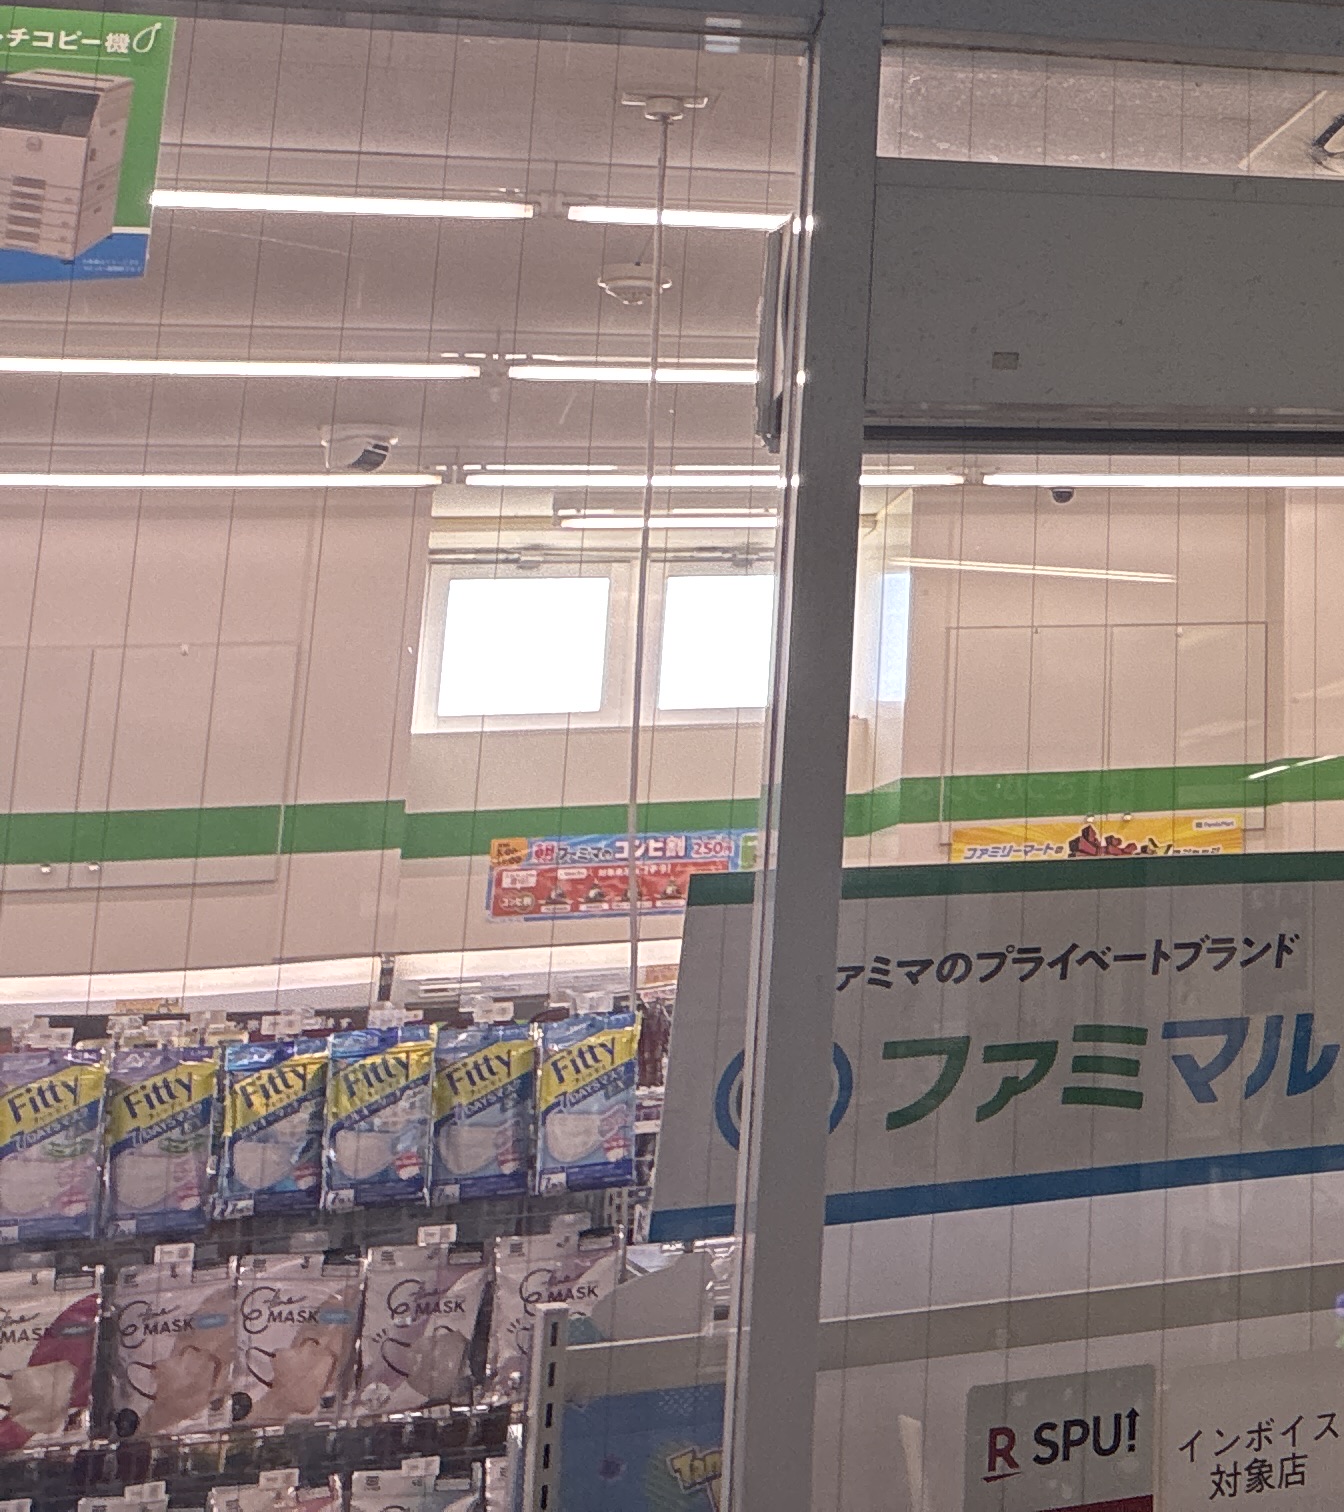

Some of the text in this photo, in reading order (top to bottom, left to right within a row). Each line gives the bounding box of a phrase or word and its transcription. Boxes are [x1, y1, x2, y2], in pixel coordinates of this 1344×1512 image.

[0, 28, 130, 54] チコピー機
[836, 932, 1301, 992] ァミマのプライベートブランド
[446, 1049, 512, 1095] Fitty
[550, 1037, 616, 1084] Fitty
[883, 1011, 1341, 1133] ファミマル
[123, 1071, 194, 1119] Fitty
[143, 1317, 196, 1337] MASK
[267, 1308, 320, 1324] MASK
[1178, 1411, 1341, 1463] インボイス
[1208, 1454, 1310, 1500] 対象店
